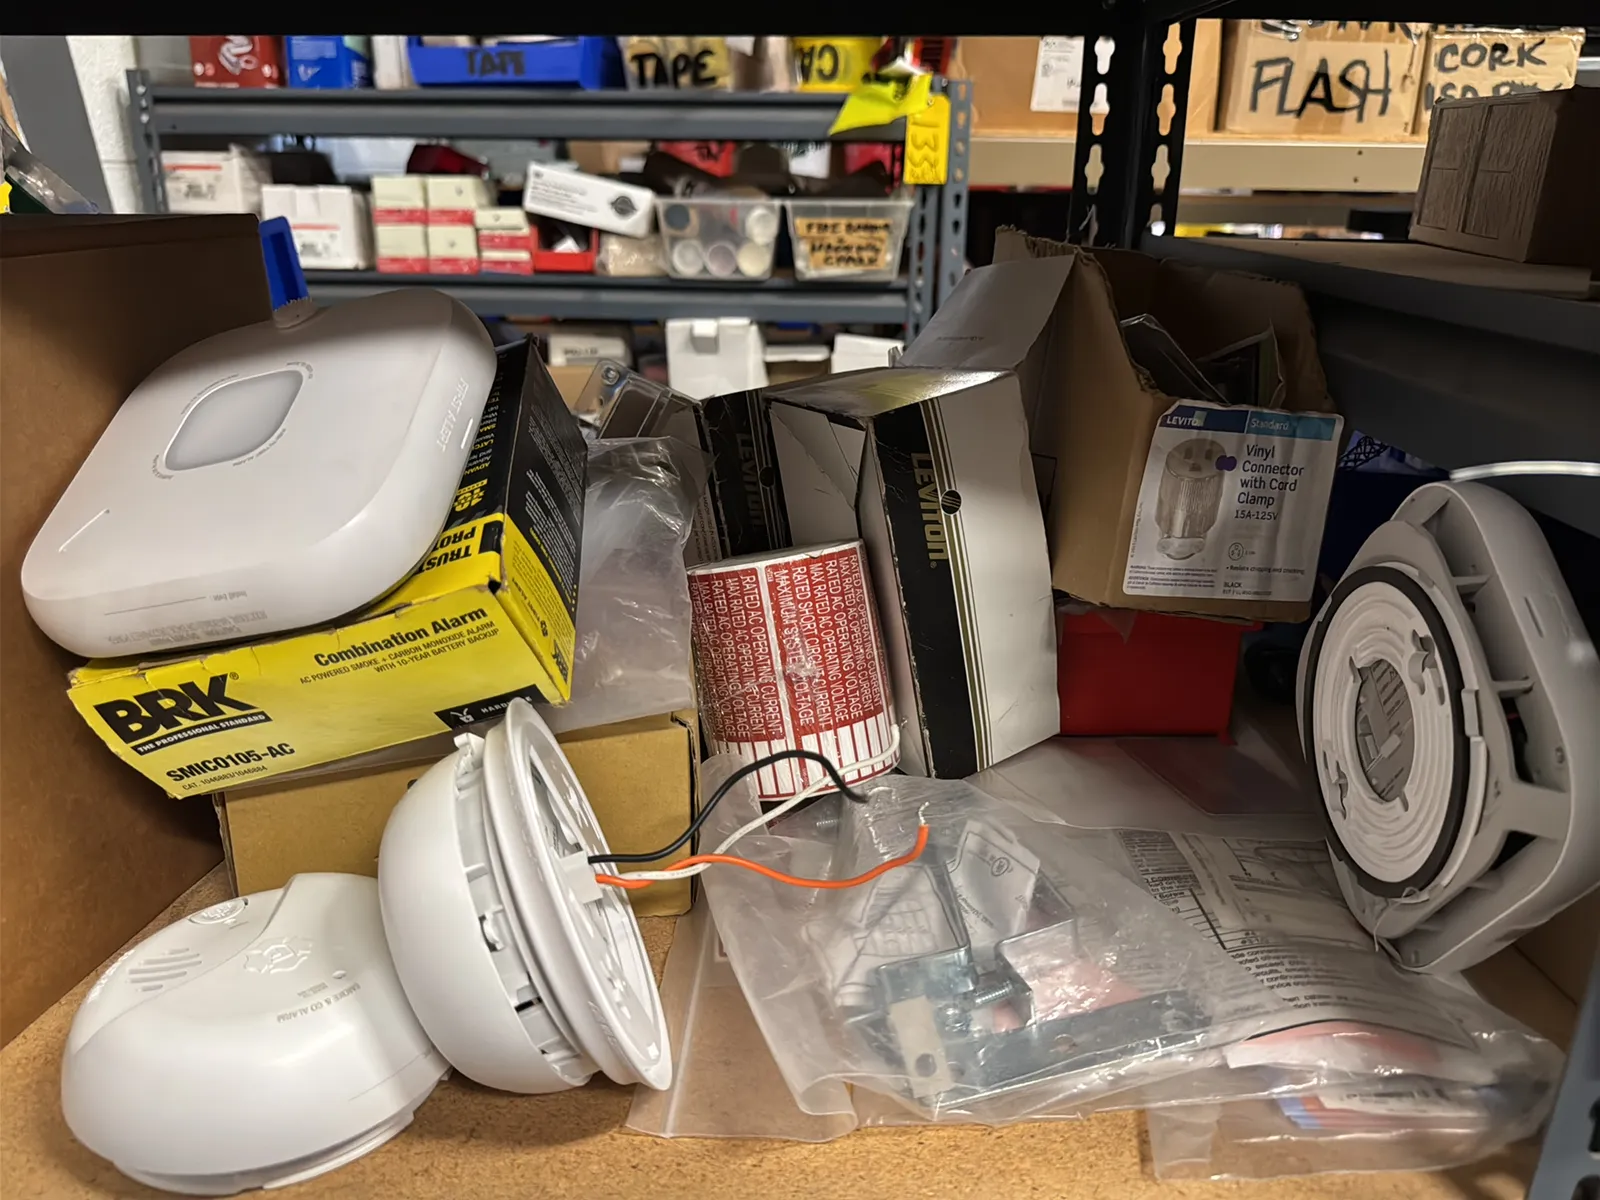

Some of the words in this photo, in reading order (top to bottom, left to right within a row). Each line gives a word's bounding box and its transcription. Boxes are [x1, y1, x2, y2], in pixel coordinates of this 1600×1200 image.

[631, 50, 717, 88] TAPE
[1435, 38, 1548, 73] CORK
[1249, 48, 1392, 123] FLASH
[1250, 417, 1289, 431] Standard
[1242, 460, 1304, 476] Connector
[1246, 444, 1275, 460] Vinyl
[1237, 492, 1275, 508] Clamp
[1240, 477, 1266, 490] with
[1269, 478, 1297, 491] Cord
[1234, 509, 1278, 521] 15A-125V
[792, 566, 811, 600] RATED
[809, 563, 825, 584] MAX
[825, 560, 842, 594] RATED
[839, 557, 851, 576] MAX
[850, 555, 862, 586] RATED
[699, 582, 711, 602] MAX
[711, 580, 728, 614] RATED
[725, 578, 741, 598] MAX
[742, 575, 760, 609] RATED
[774, 569, 797, 625] MAXIMUM
[813, 584, 830, 615] RATED
[831, 595, 845, 611] AC
[842, 577, 856, 606] RATED
[855, 588, 865, 602] AC
[703, 602, 717, 632] RATED
[717, 615, 731, 630] AC
[729, 599, 746, 628] RATED
[747, 609, 763, 625] AC
[798, 601, 818, 636] SHORT
[818, 615, 833, 629] AC
[847, 607, 858, 620] AC
[313, 627, 430, 667] Combination
[430, 607, 488, 635] Alarm
[708, 632, 719, 645] AC
[734, 629, 749, 642] AC
[834, 612, 855, 671] OPERATING
[850, 621, 867, 670] OPERATING
[858, 604, 874, 659] OPERATING
[300, 676, 312, 685] AC
[312, 665, 351, 682] POWERED
[352, 658, 379, 672] SMOKE
[388, 646, 422, 661] CARBON
[423, 632, 465, 651] MONOXIDE
[466, 620, 495, 636] ALARM
[374, 661, 396, 674] WITH
[397, 652, 432, 668] 10-YEAR
[432, 641, 467, 657] BATTERY
[467, 627, 500, 645] BACKUP
[720, 632, 741, 690] OPERATING
[750, 626, 773, 684] OPERATING
[784, 626, 805, 672] SYSTE
[821, 629, 842, 681] OPERATING
[711, 646, 728, 696] OPERATING
[737, 643, 758, 692] OPERATING
[867, 660, 882, 707] CURRENT
[812, 679, 833, 728] CURRENT
[829, 681, 849, 723] VOLTAGE
[844, 671, 863, 719] VOLTAGE
[858, 671, 874, 711] CURRENT
[720, 698, 736, 737] VOLTAGE
[731, 691, 750, 738] VOLTAGE
[746, 693, 765, 736] CURRENT
[761, 685, 782, 733] CURRENT
[137, 741, 155, 753] THE
[156, 723, 220, 747] PROFESSIONAL
[220, 714, 265, 729] STANDARD
[182, 780, 200, 791] CAT.
[310, 1001, 323, 1012] CO
[332, 982, 360, 1002] SMOKE
[276, 1006, 309, 1023] ALARM
